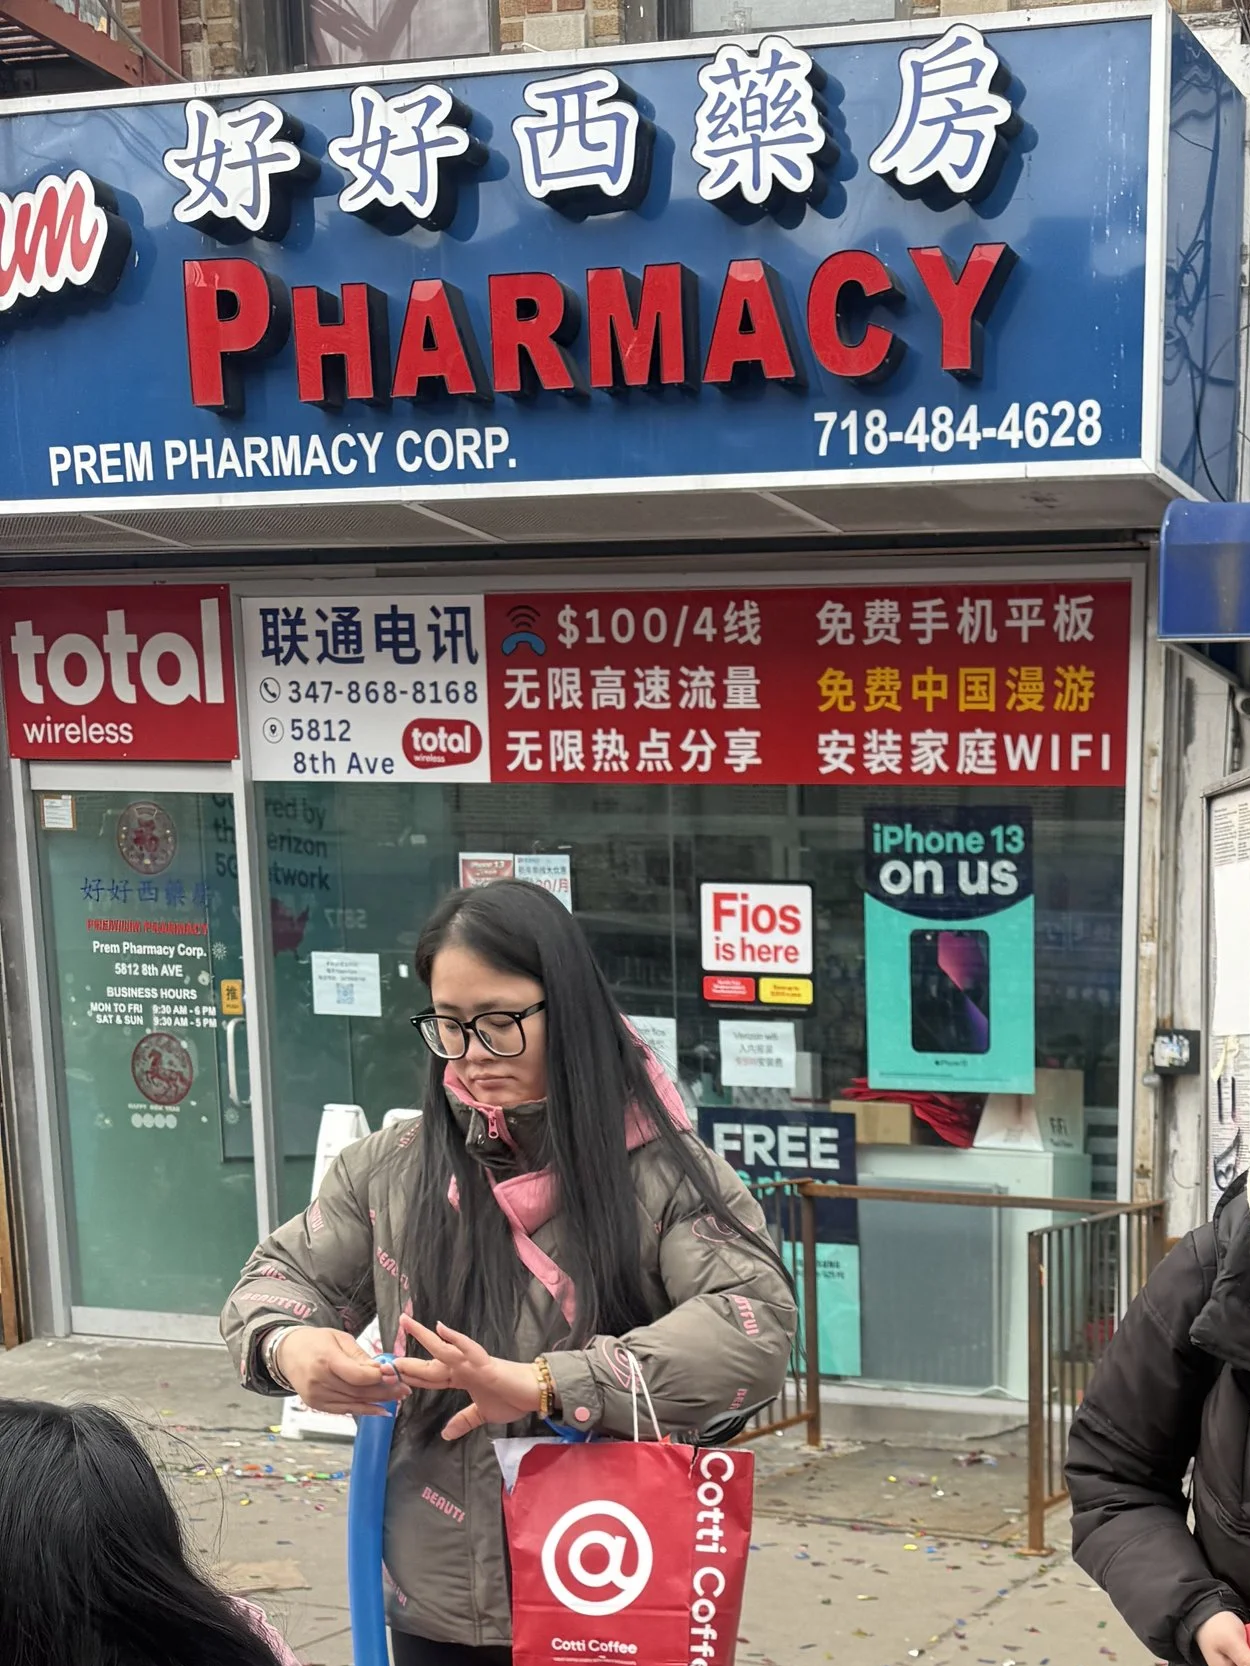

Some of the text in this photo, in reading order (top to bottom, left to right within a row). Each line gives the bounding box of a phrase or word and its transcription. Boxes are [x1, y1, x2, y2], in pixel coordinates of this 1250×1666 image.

[165, 23, 1011, 231] 好好西藥房
[183, 242, 1008, 406] PHARMACY
[813, 400, 1102, 457] 718-484-4628
[49, 427, 517, 486] PREM PHARMACY CORP.
[260, 605, 479, 667] 联通电讯
[557, 600, 763, 647] $100/4线
[815, 595, 1096, 646] 免费手机平板
[11, 597, 225, 706] total
[288, 680, 478, 704] 347-868-8168
[503, 664, 763, 711] 无限高速流量
[816, 664, 1096, 714] 免费中国漫游
[22, 715, 134, 744] wireless
[290, 719, 352, 742] 5812
[411, 725, 471, 753] total
[293, 752, 395, 774] 8th Ave
[413, 754, 446, 763] wireless
[505, 727, 763, 774] 无限热点分享
[817, 728, 1112, 776] 安装家庭WIFI
[267, 828, 328, 858] erizon
[873, 824, 1025, 854] iPhone 13
[879, 859, 1019, 896] on us
[144, 921, 208, 937] PHARMACY
[712, 892, 802, 935] Fios
[92, 940, 208, 959] Prem Pharmacy Corp.
[715, 937, 800, 963] is here
[114, 963, 184, 977] 5812 8th AVE
[90, 1002, 112, 1013] MON
[113, 1003, 127, 1013] TO
[128, 1003, 143, 1013] FRI
[173, 1005, 188, 1015] AM
[202, 1006, 216, 1016] PM
[106, 986, 197, 1000] BUSINESS HOURS
[95, 1015, 113, 1024] SAT
[124, 1016, 144, 1025] SUN
[173, 1017, 188, 1027] AM
[202, 1018, 217, 1028] PM
[712, 1122, 841, 1170] FREE
[694, 1451, 735, 1555] Cotti
[551, 1637, 638, 1655] Cotti Coffee
